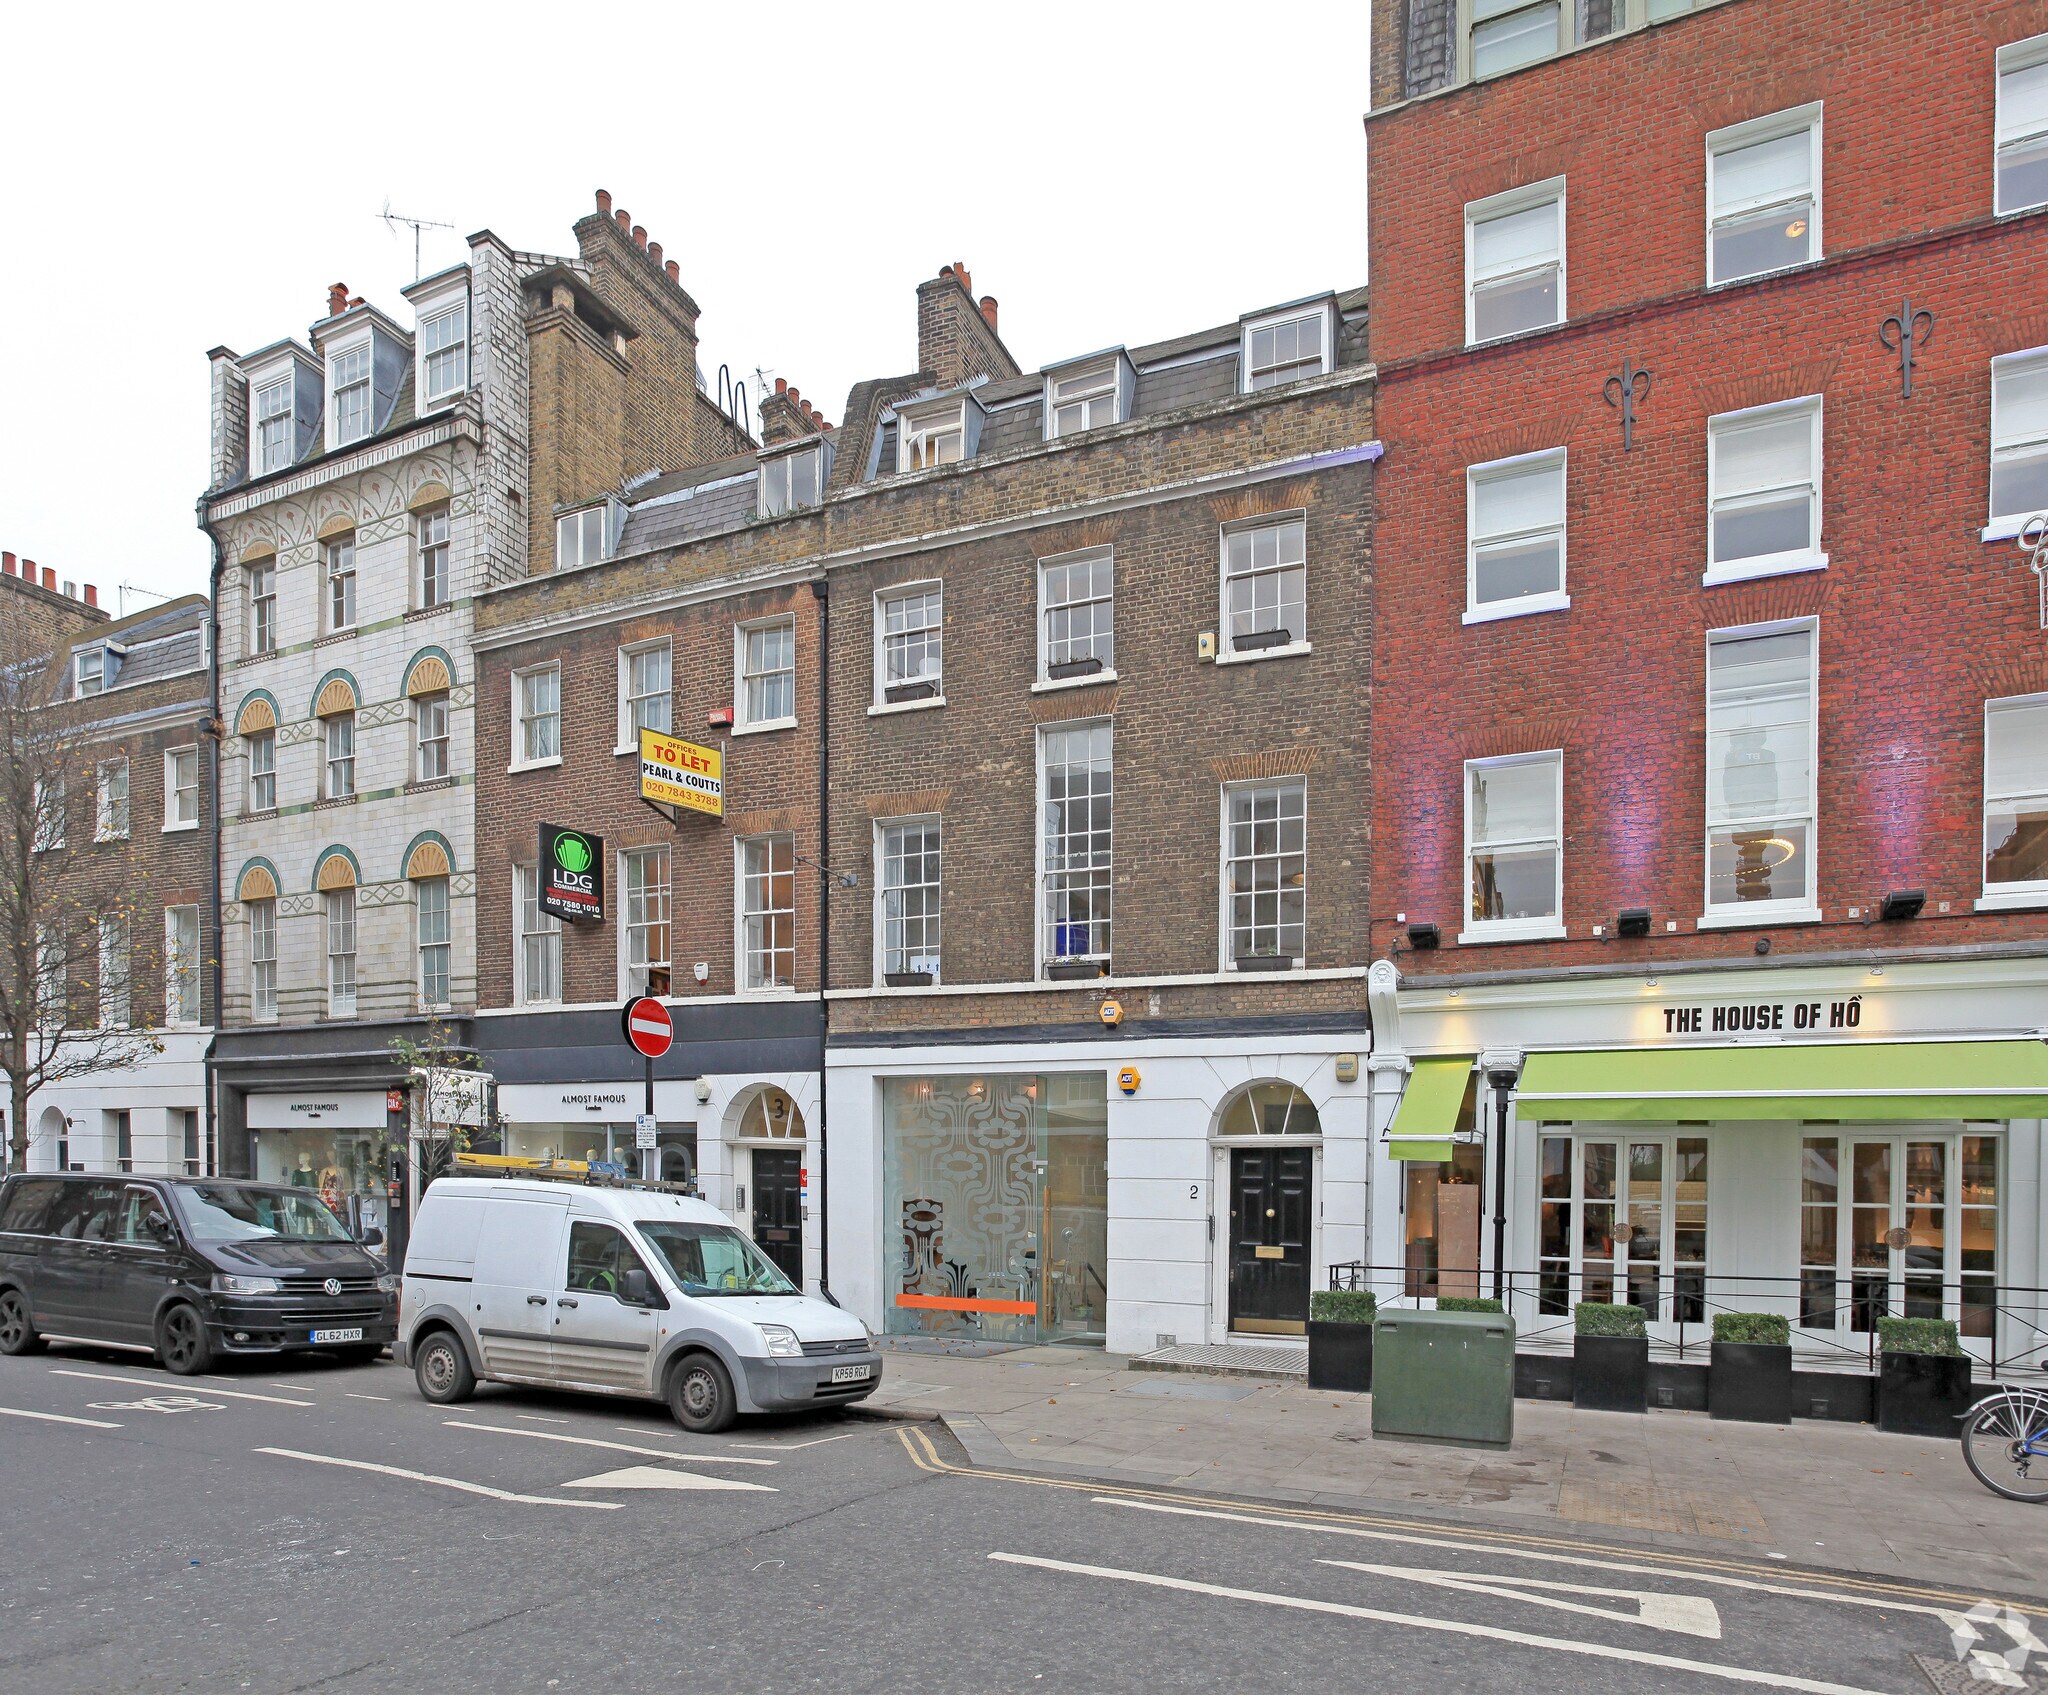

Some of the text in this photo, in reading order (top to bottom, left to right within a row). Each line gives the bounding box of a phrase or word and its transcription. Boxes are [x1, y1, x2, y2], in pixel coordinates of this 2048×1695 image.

[667, 741, 697, 755] OFFICES
[653, 744, 711, 772] TO LET
[643, 762, 720, 793] PEARL & COUTTS
[645, 781, 718, 807] 020 7843 3788
[553, 868, 592, 889] LDG
[553, 882, 592, 895] COMMERCIAL
[546, 897, 561, 906] 020
[562, 900, 581, 909] 7580
[582, 904, 600, 913] 1010
[1663, 1007, 1702, 1033] THE
[1712, 1004, 1783, 1032] HOUSE
[1793, 1003, 1821, 1029] OF
[561, 1094, 626, 1103] ALMOST FAMOUS
[314, 1103, 339, 1111] FAMOUS
[774, 1098, 784, 1119] 3
[1189, 1184, 1199, 1200] 2
[316, 1330, 361, 1341] GL62 HXR
[854, 1366, 868, 1378] RGX
